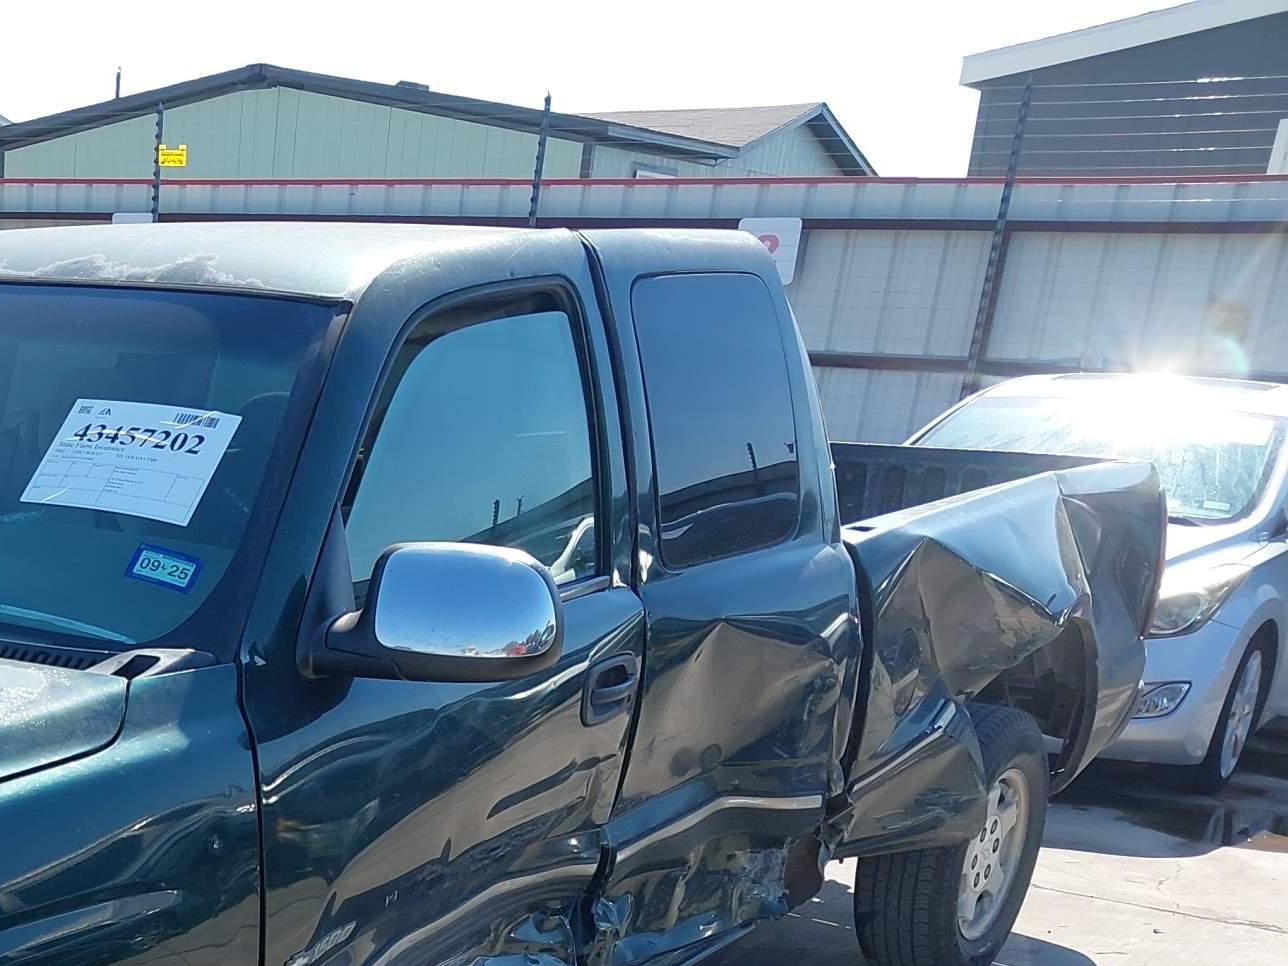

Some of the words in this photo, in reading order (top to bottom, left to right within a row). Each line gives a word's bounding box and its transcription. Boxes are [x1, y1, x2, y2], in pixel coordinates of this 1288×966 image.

[73, 423, 206, 455] 43457202
[94, 444, 126, 452] Insurance
[139, 557, 161, 572] 09
[167, 564, 191, 580] 25
